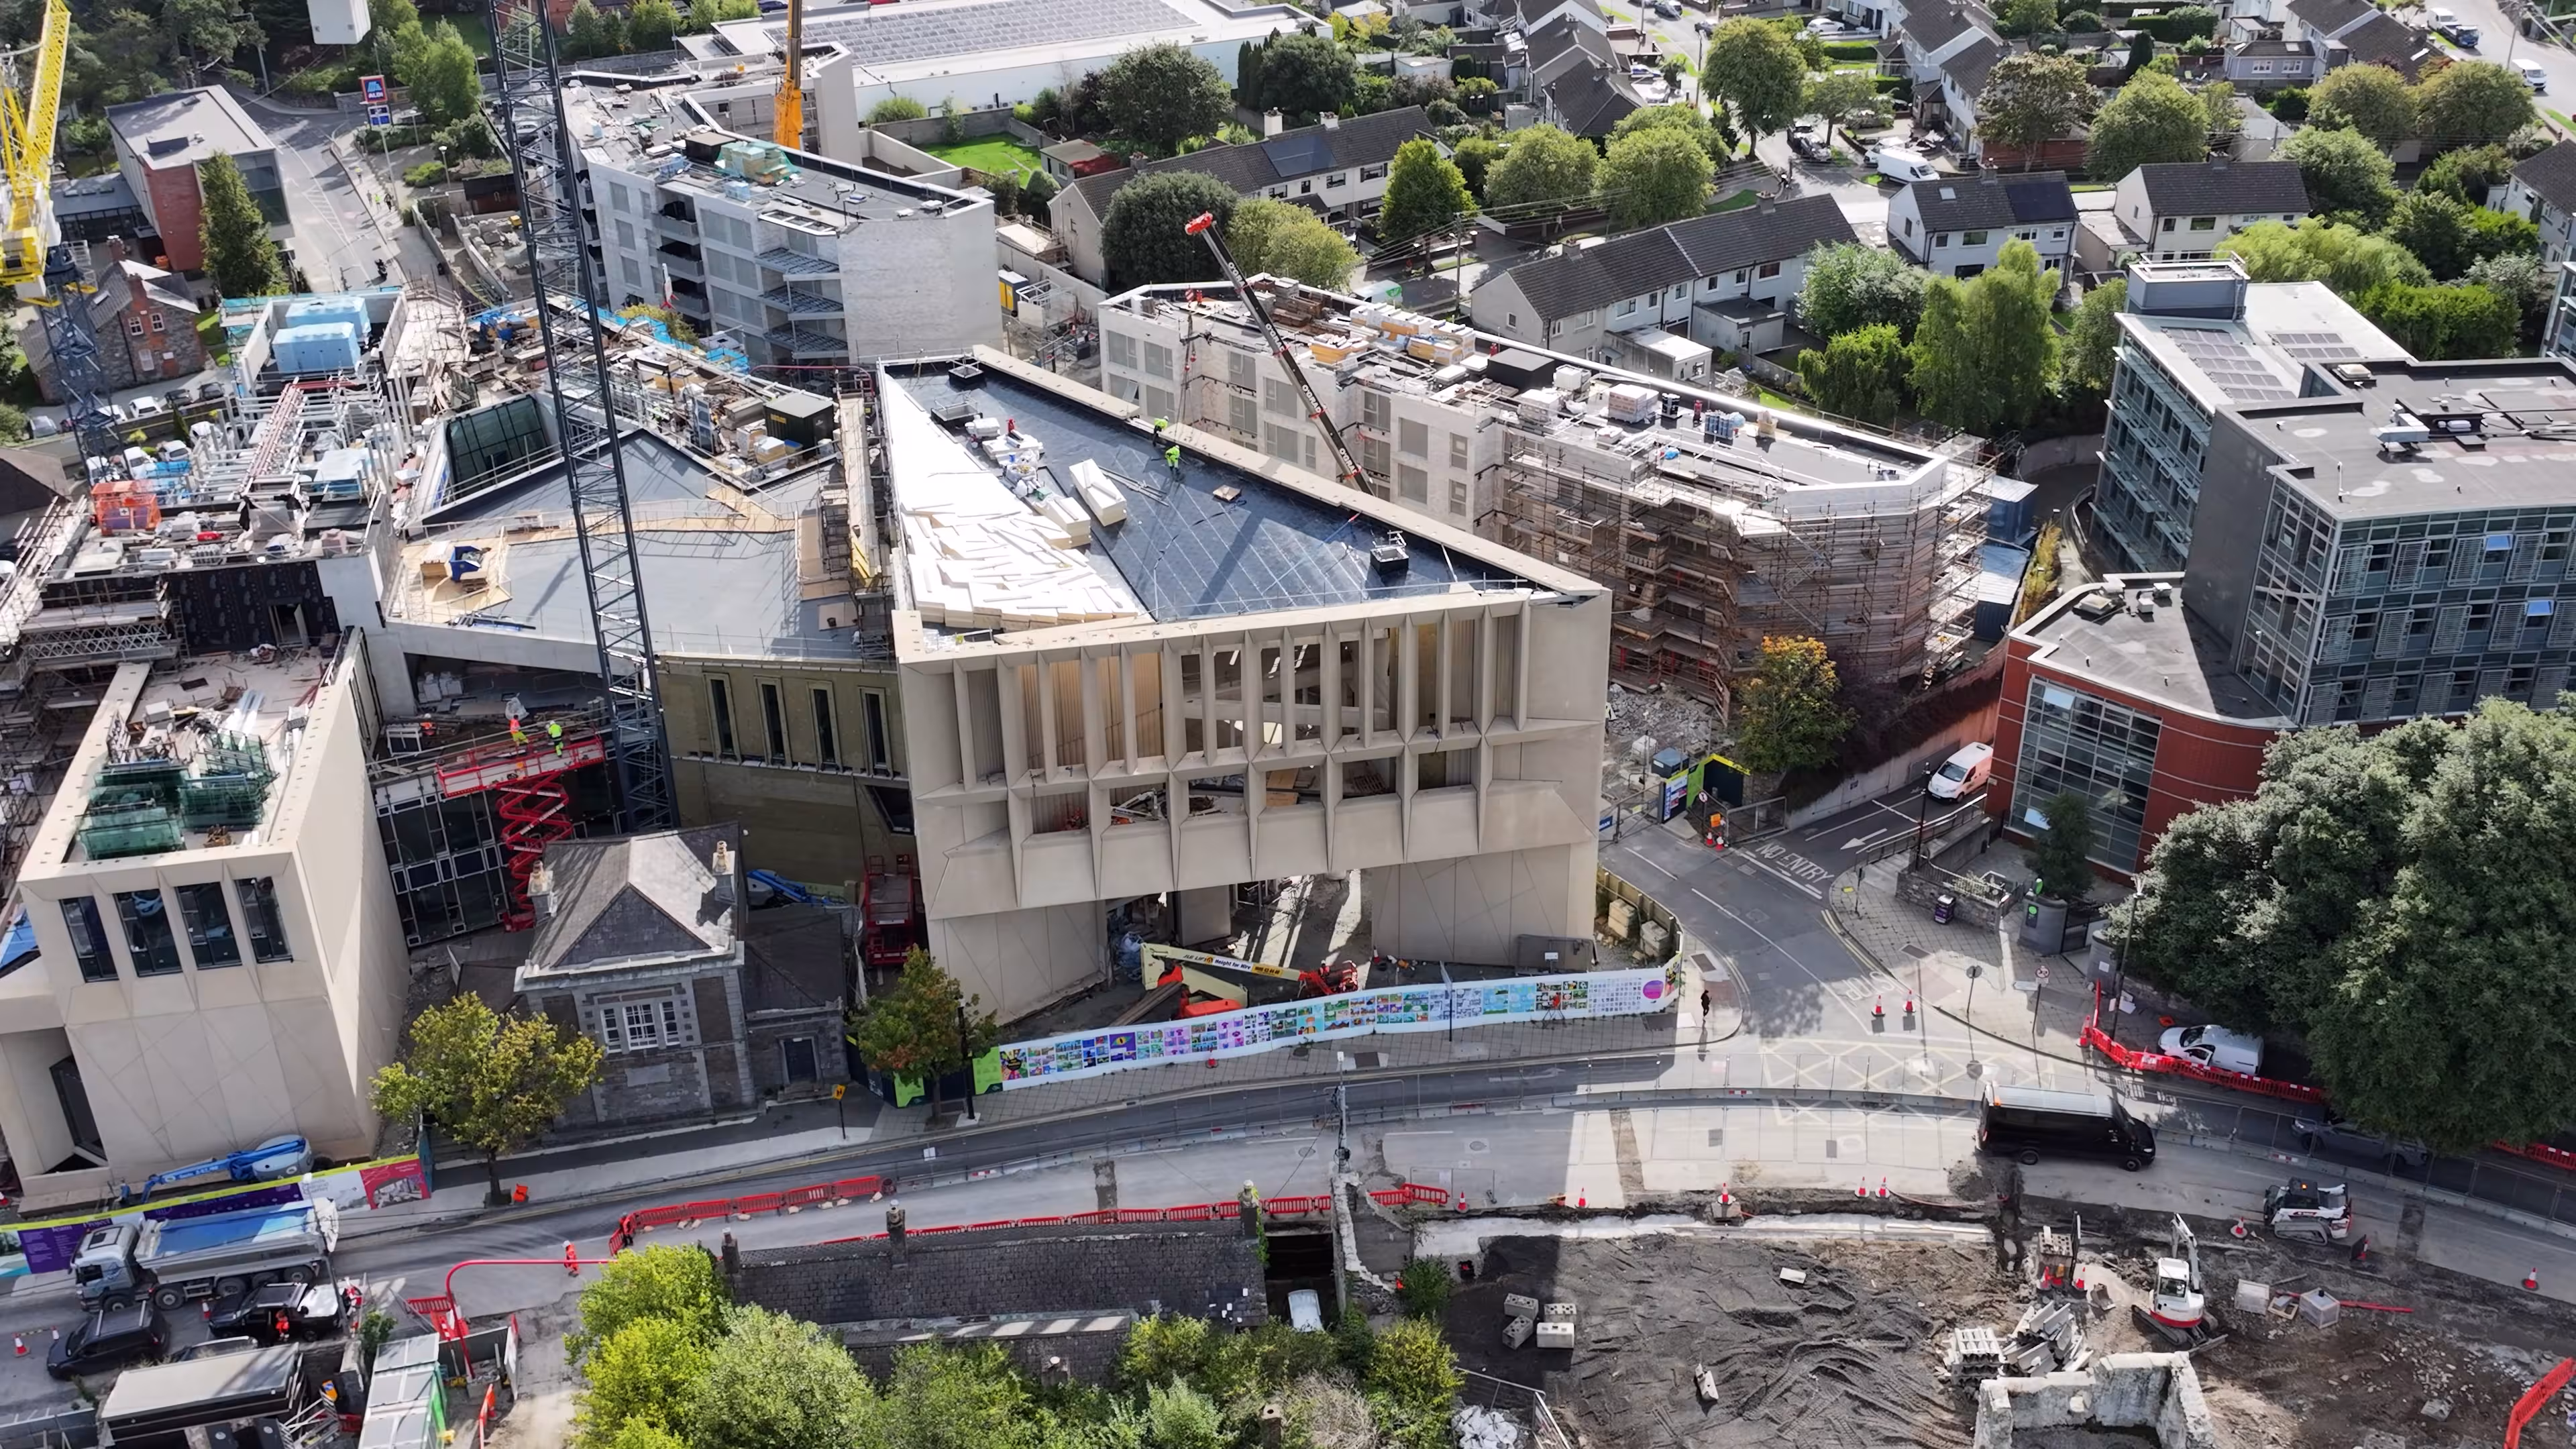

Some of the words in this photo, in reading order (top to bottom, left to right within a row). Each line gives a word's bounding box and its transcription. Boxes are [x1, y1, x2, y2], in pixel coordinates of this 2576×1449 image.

[1755, 841, 1786, 859] NO
[1776, 853, 1835, 883] ENTRY
[1841, 971, 1895, 1001] STOP
